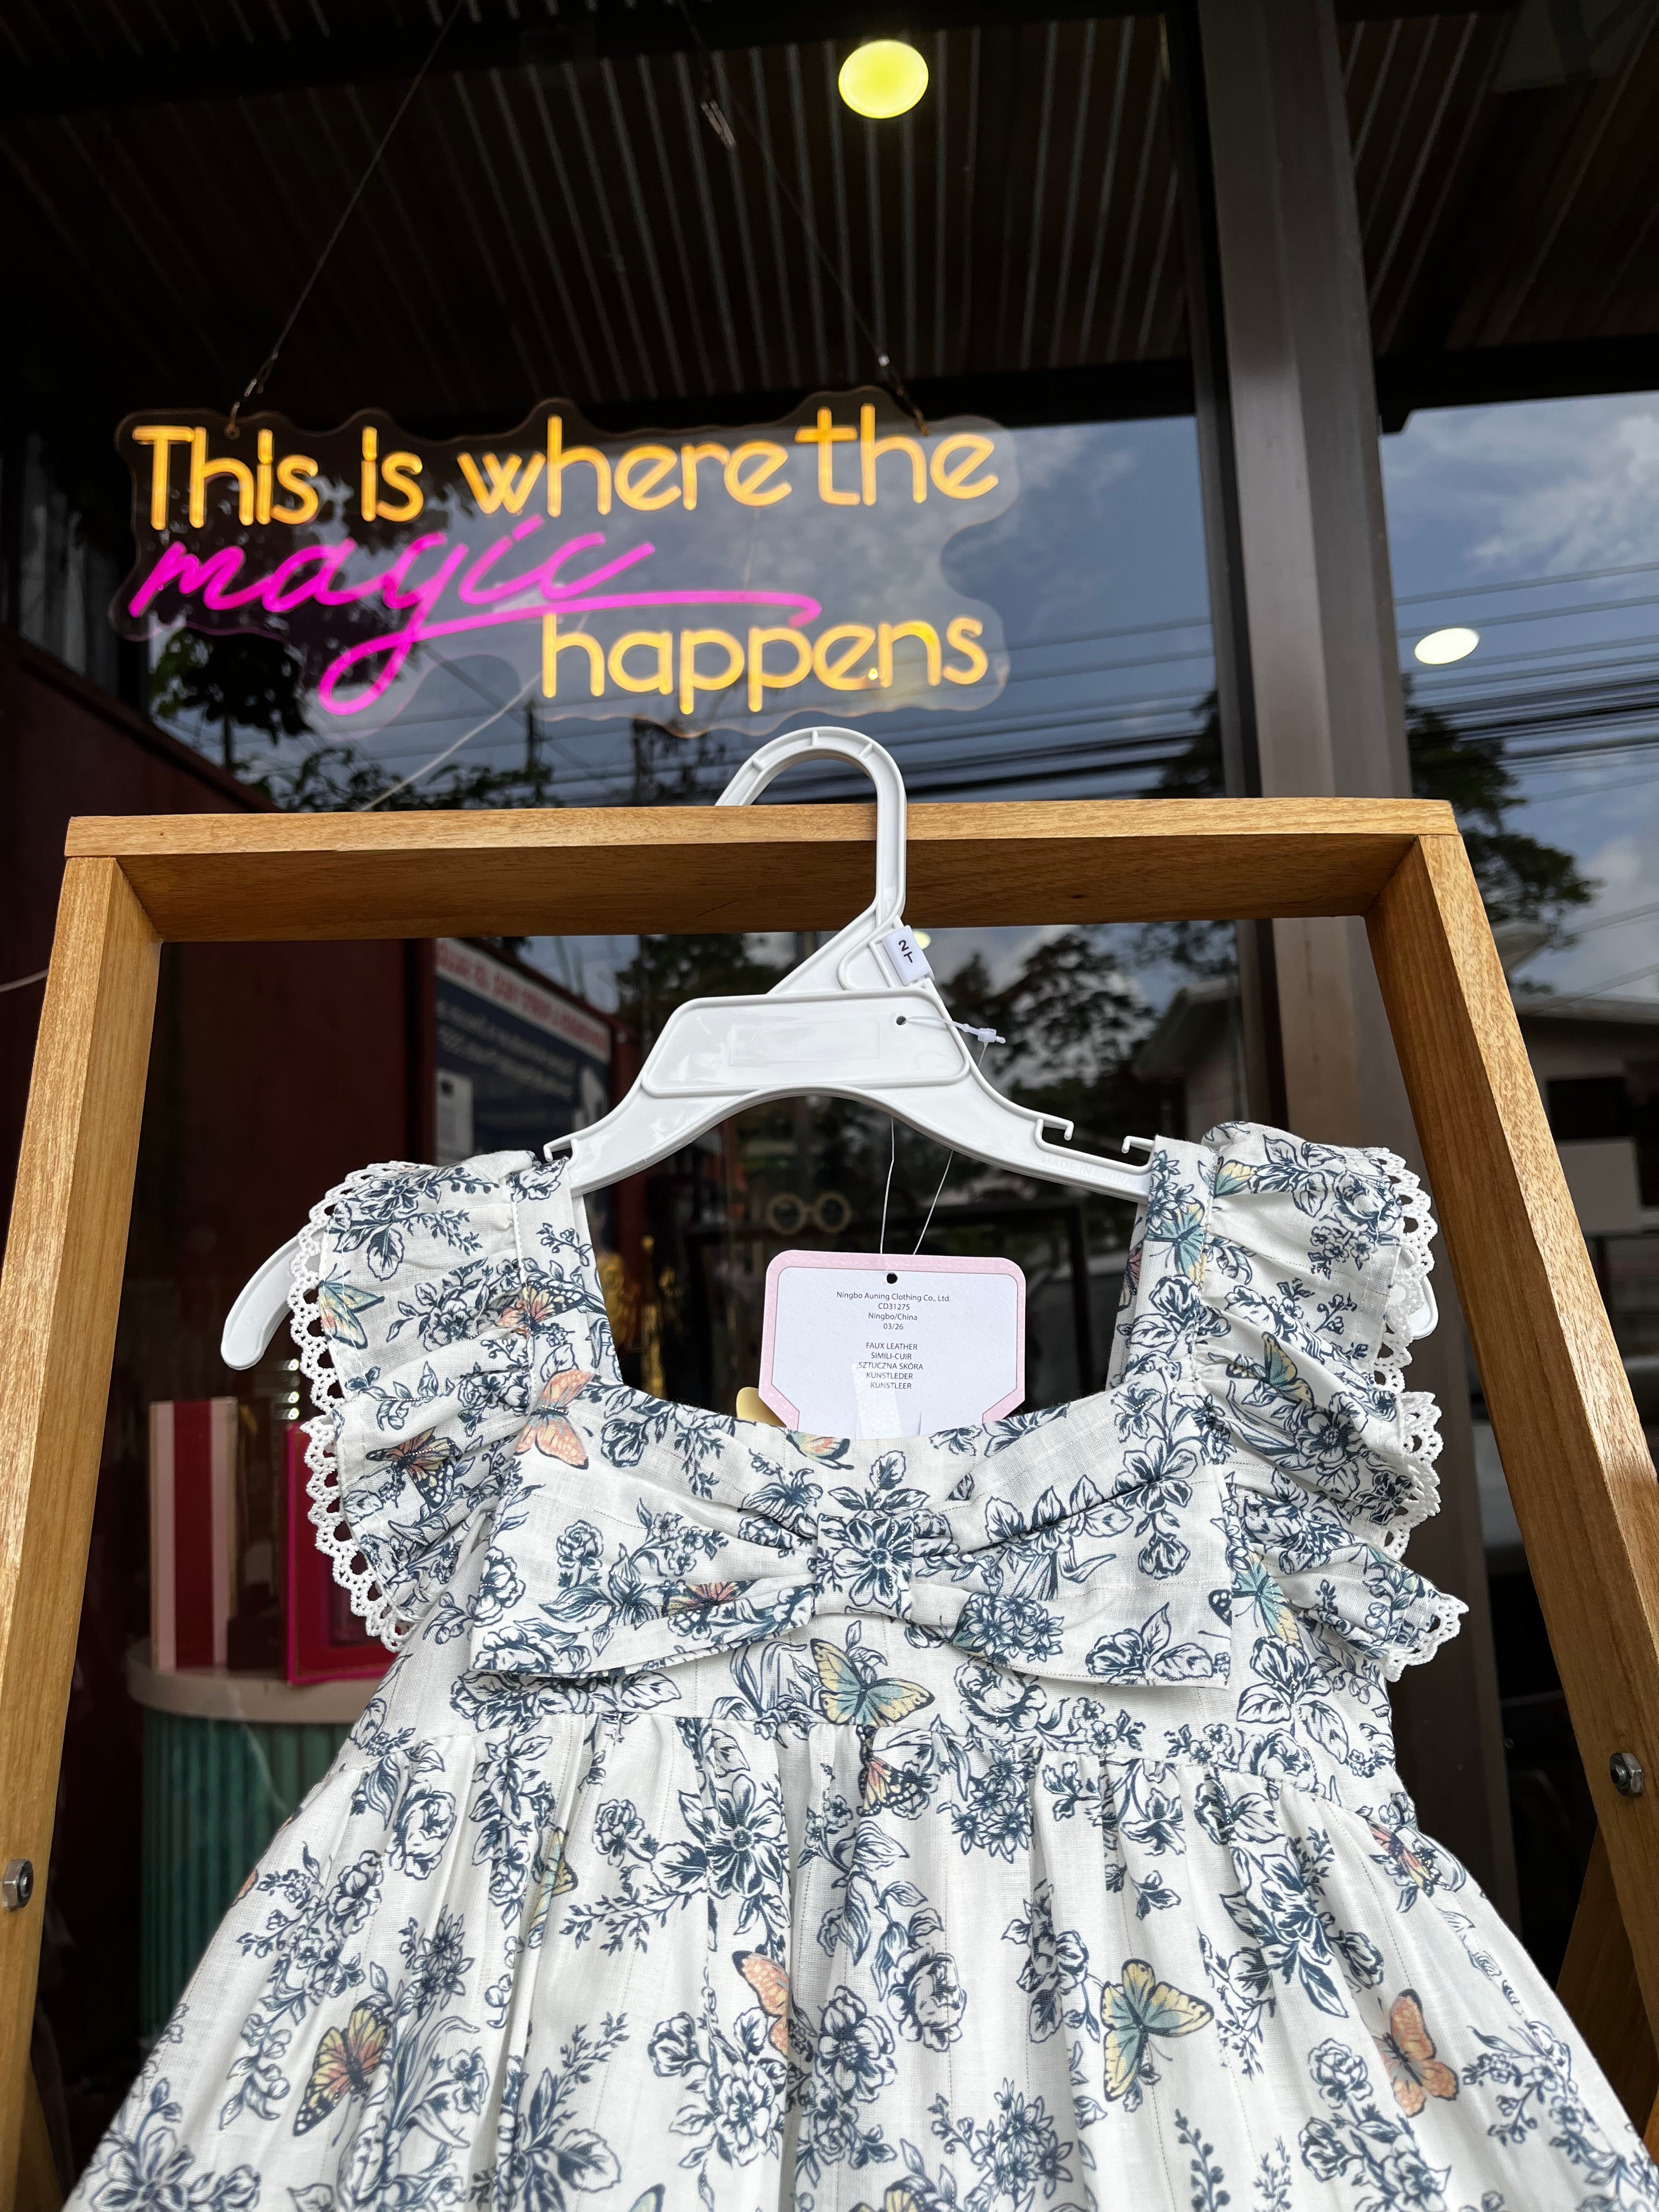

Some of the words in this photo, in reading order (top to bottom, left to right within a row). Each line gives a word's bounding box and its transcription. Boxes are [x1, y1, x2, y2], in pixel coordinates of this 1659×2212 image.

[132, 424, 319, 531] This
[361, 426, 424, 523] is
[458, 415, 791, 516] where
[794, 402, 998, 505] the
[129, 515, 822, 715] magic
[543, 613, 988, 715] happens
[837, 1291, 863, 1300] Ningbo
[864, 1292, 890, 1301] Auning
[891, 1293, 922, 1302] Clothing
[923, 1294, 936, 1302] Co.,
[878, 1302, 910, 1311] CD31275
[868, 1312, 918, 1321] Ningbo/China
[886, 1342, 918, 1351] LEATHER
[871, 1352, 912, 1360] SIMILI-CUIR
[858, 1361, 898, 1369] SZTUCZNA
[899, 1362, 924, 1370] SKÓRA
[866, 1372, 913, 1380] KUNSTLEDER
[870, 1381, 912, 1390] KUNSTLEER
